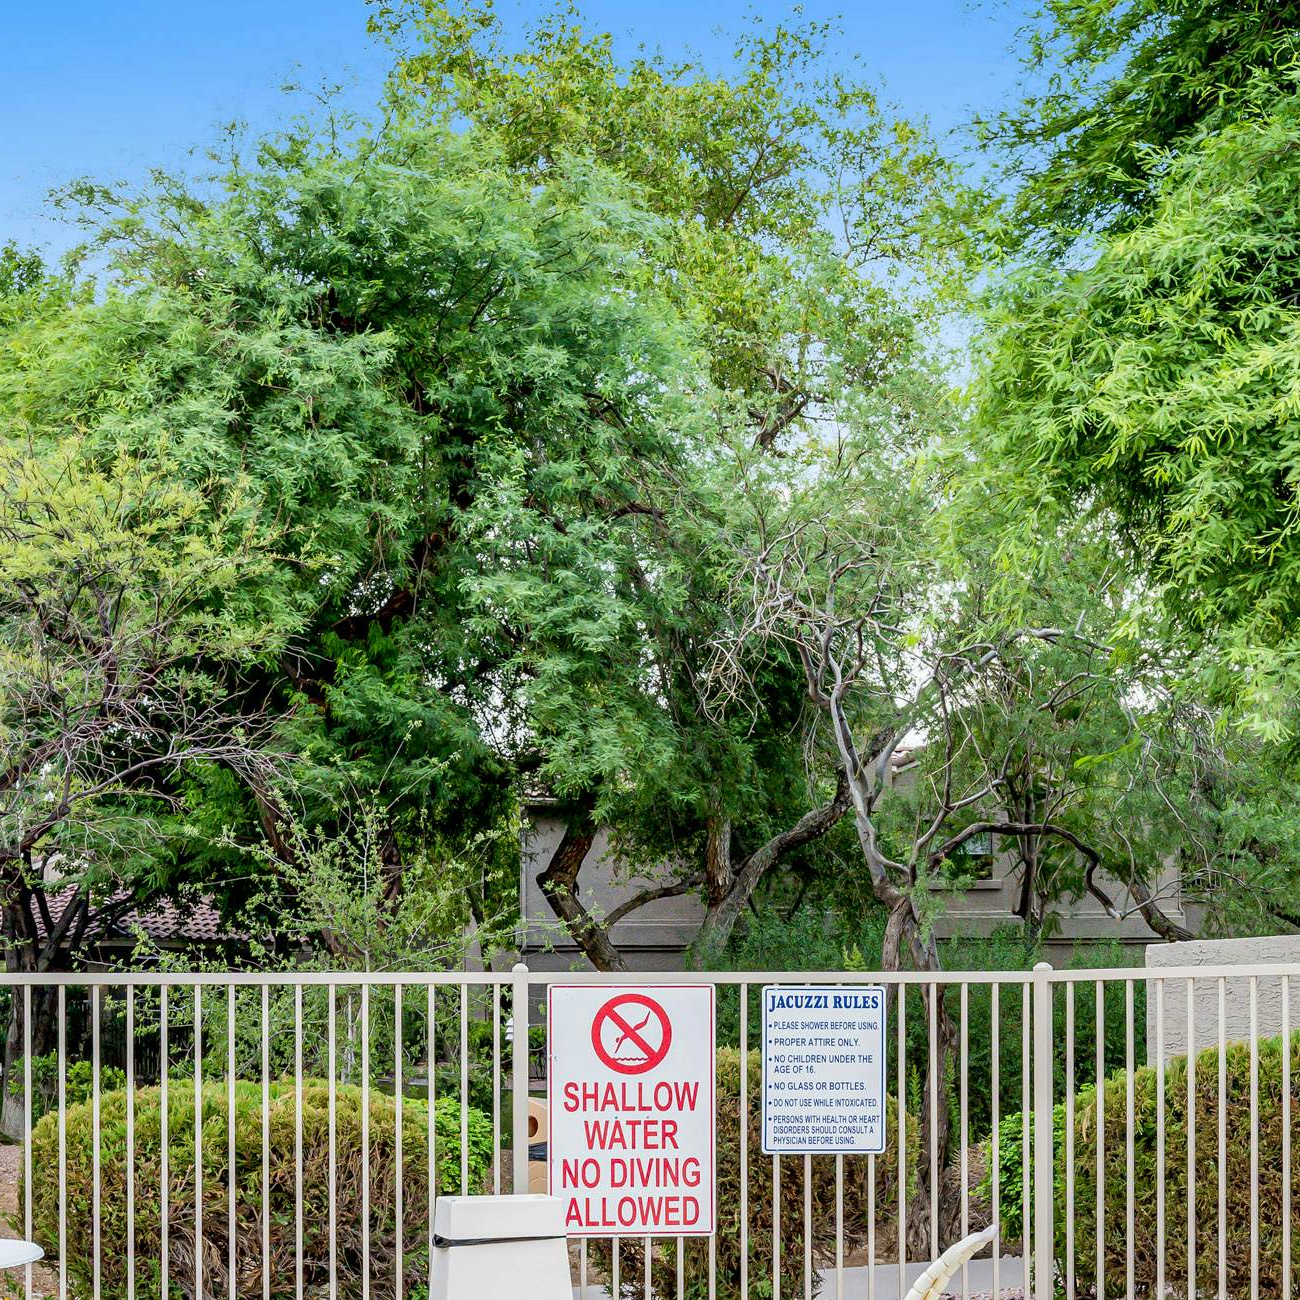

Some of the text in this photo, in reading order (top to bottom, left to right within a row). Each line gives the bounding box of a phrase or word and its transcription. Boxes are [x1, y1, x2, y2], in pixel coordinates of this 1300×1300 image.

[769, 995, 879, 1013] JACUZZI RULES
[773, 1021, 879, 1030] PLEASE SHOWER BEFORE USING.
[774, 1038, 861, 1047] PROPER ATTIRE ONLY.
[774, 1054, 873, 1063] NO CHILDREN UNDER THE
[774, 1065, 816, 1074] AGE OF 16.
[773, 1081, 867, 1091] NO GLASS OR BOTTLES.
[563, 1081, 700, 1113] SHALLOW
[773, 1098, 783, 1108] DO
[784, 1098, 798, 1108] NOT
[799, 1098, 812, 1108] USE
[813, 1098, 834, 1108] WHILE
[773, 1115, 880, 1124] PERSONS WITH HEALTH OR HEART
[584, 1119, 679, 1151] WATER
[773, 1125, 874, 1135] DISORDERS SHOULD CONSULT A
[773, 1136, 857, 1146] PHYSICIAN BEFORE USING.
[562, 1157, 701, 1189] NO DIVING
[565, 1196, 700, 1227] ALLOWED
